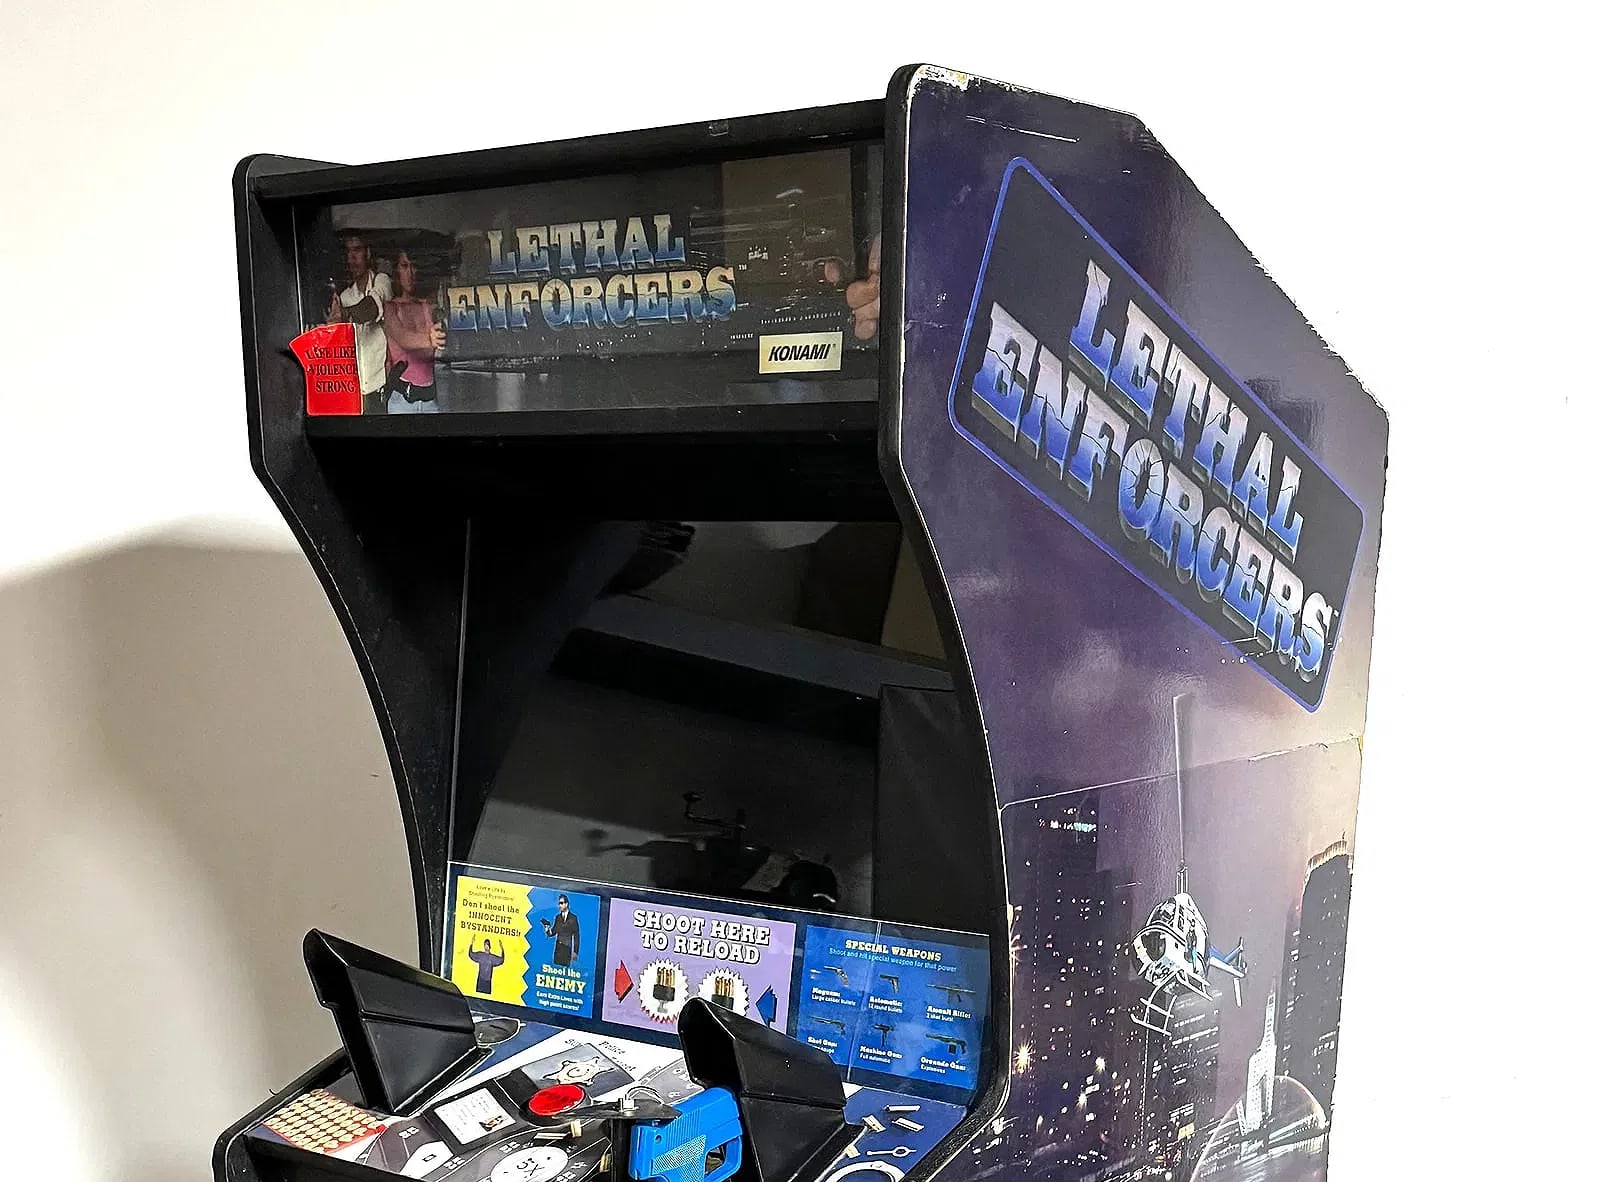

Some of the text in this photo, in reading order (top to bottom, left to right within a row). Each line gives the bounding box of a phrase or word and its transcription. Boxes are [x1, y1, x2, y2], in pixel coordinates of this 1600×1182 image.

[487, 213, 686, 276] LETHAL
[447, 266, 737, 333] ENFORCERS
[768, 343, 832, 362] KONAMI
[316, 380, 356, 392] STRONG
[1070, 258, 1305, 562] LETHAL
[972, 301, 1334, 682] ENFORCERS
[468, 910, 513, 925] INNOCENT
[484, 902, 505, 912] shoot
[507, 905, 520, 914] the
[633, 909, 771, 946] SHOOT HERE
[641, 930, 760, 965] TO RELOAD
[845, 939, 942, 962] SPECIAL WEAPONS
[542, 963, 581, 979] Shoot the
[535, 973, 587, 995] ENEMY
